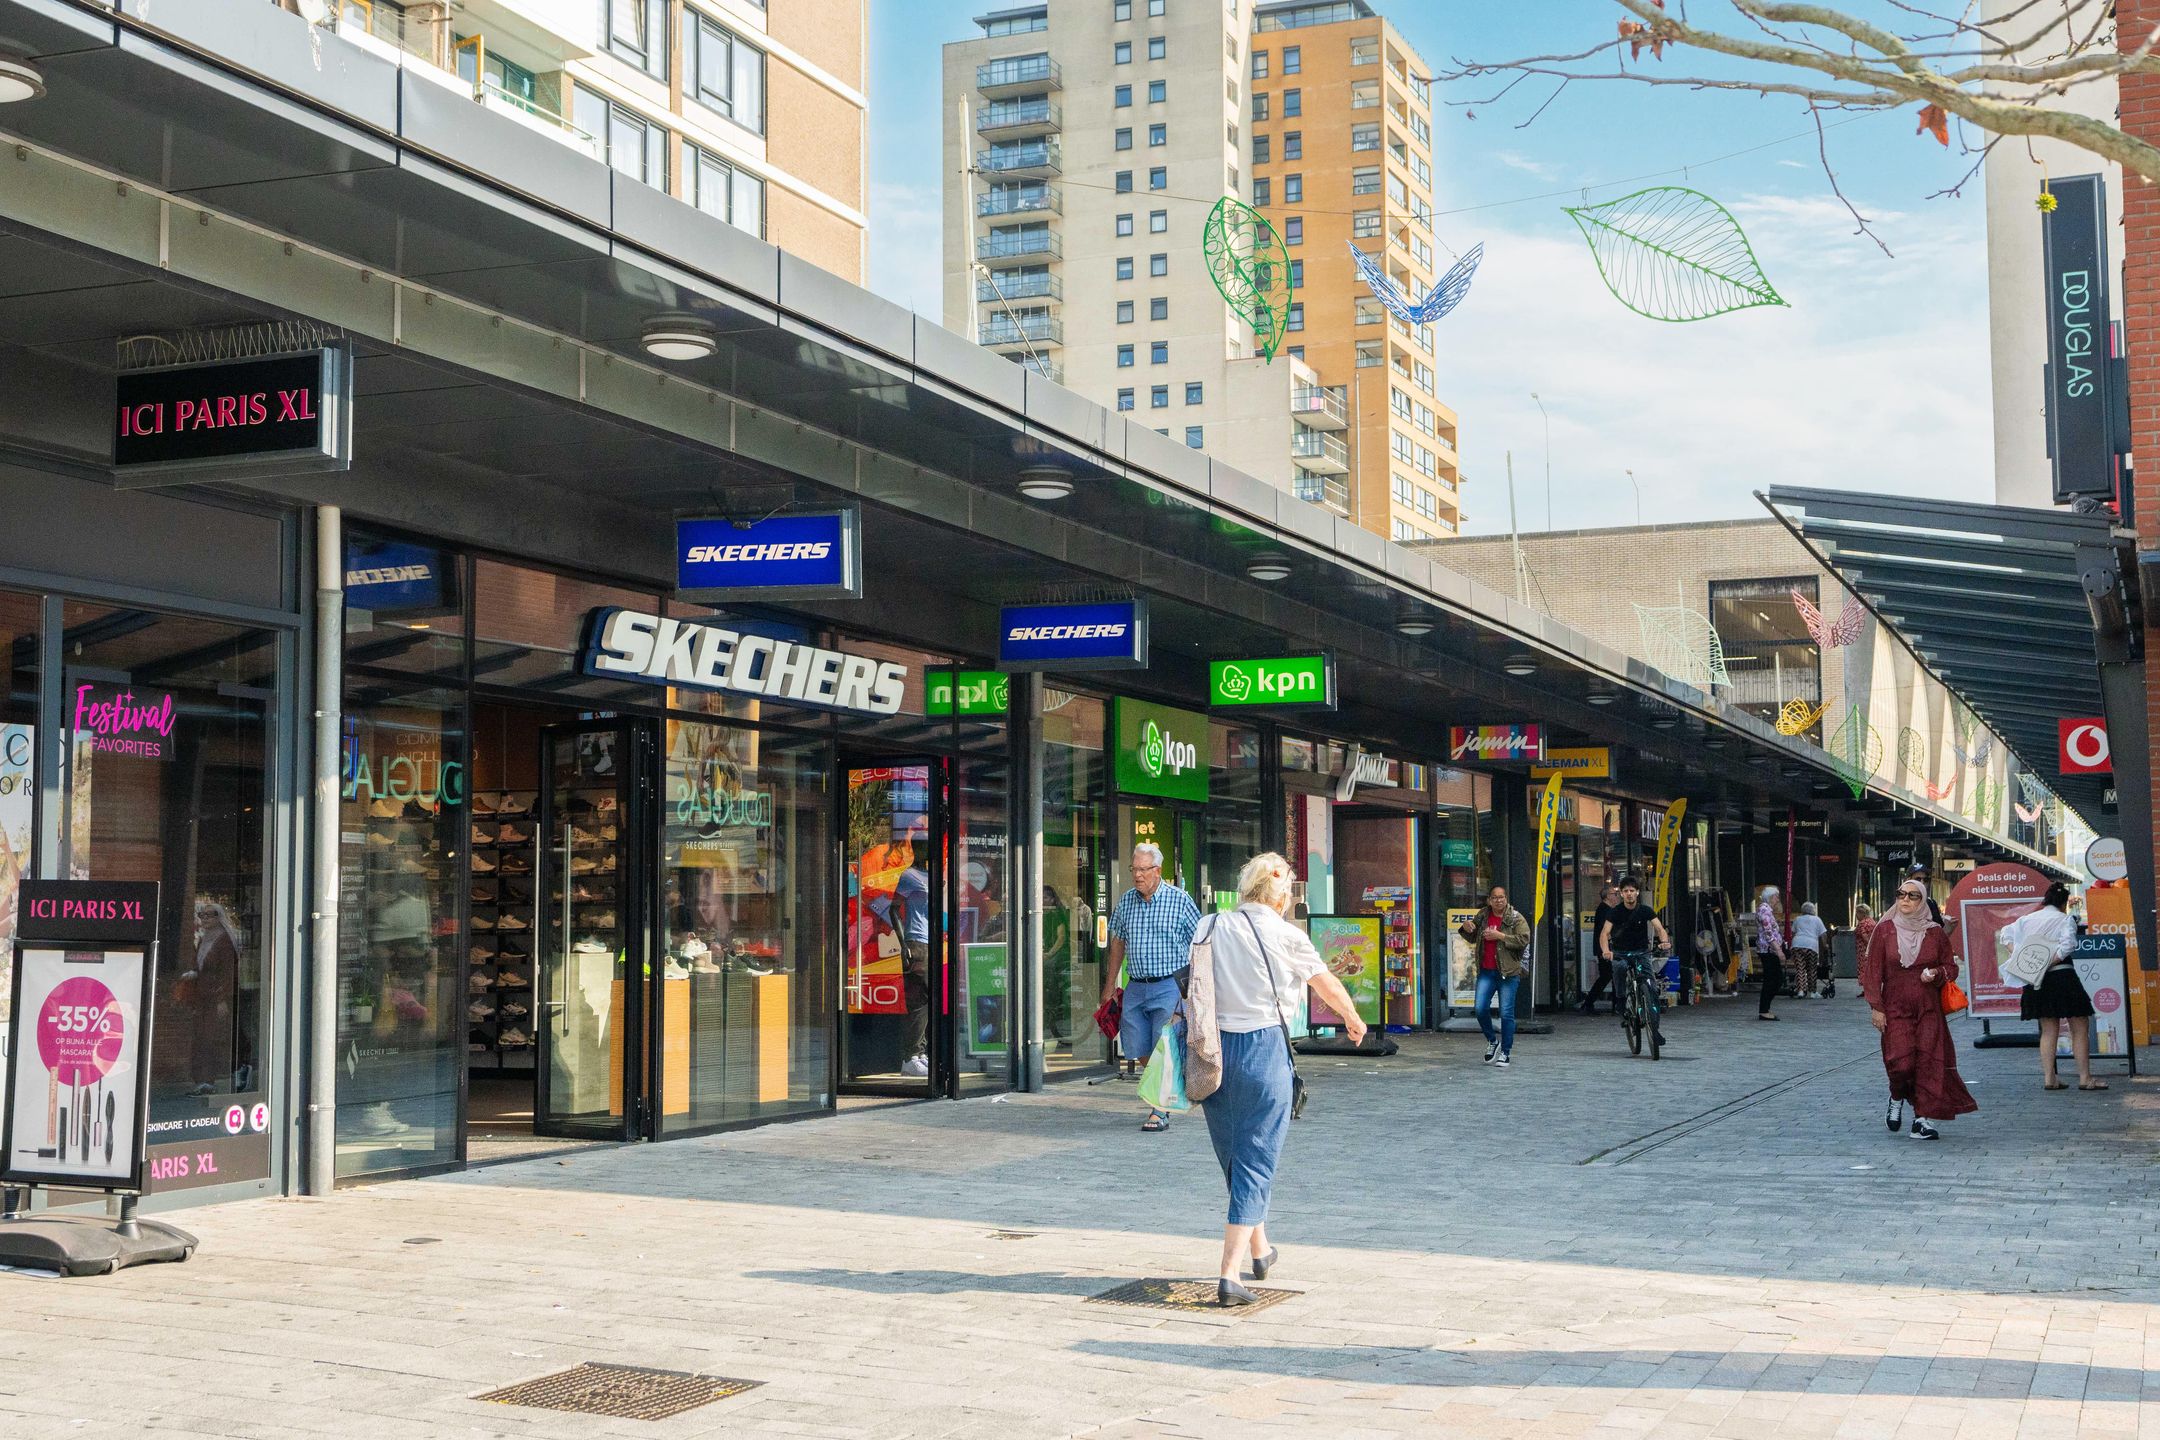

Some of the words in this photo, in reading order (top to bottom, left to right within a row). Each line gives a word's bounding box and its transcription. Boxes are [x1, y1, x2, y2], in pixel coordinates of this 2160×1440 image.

[2062, 269, 2093, 398] DOUGLAS
[121, 402, 164, 437] ICI
[175, 392, 268, 432] PARIS
[276, 387, 316, 421] XL
[686, 542, 831, 564] SKECHERS
[1007, 623, 1126, 641] SKECHERS
[594, 609, 908, 715] SKECHERS
[1257, 668, 1316, 697] kpn
[74, 685, 177, 737] Festival
[90, 736, 161, 757] FAVORITES
[1164, 731, 1196, 776] kpn
[1451, 730, 1538, 761] jamin
[1977, 873, 2002, 882] Deals
[2003, 872, 2017, 881] die
[2018, 872, 2027, 882] je
[1972, 885, 1990, 894] niet
[1991, 885, 2008, 894] laat
[2009, 884, 2035, 894] lopen
[30, 899, 56, 919] ICI
[63, 899, 116, 920] PARIS
[121, 901, 144, 920] XL
[1331, 924, 1361, 936] SOUR
[48, 1005, 111, 1033] -35%
[86, 1038, 103, 1046] ALLE
[147, 1120, 183, 1133] SKINCARE
[190, 1116, 220, 1128] CADEAU
[196, 1152, 218, 1175] XL
